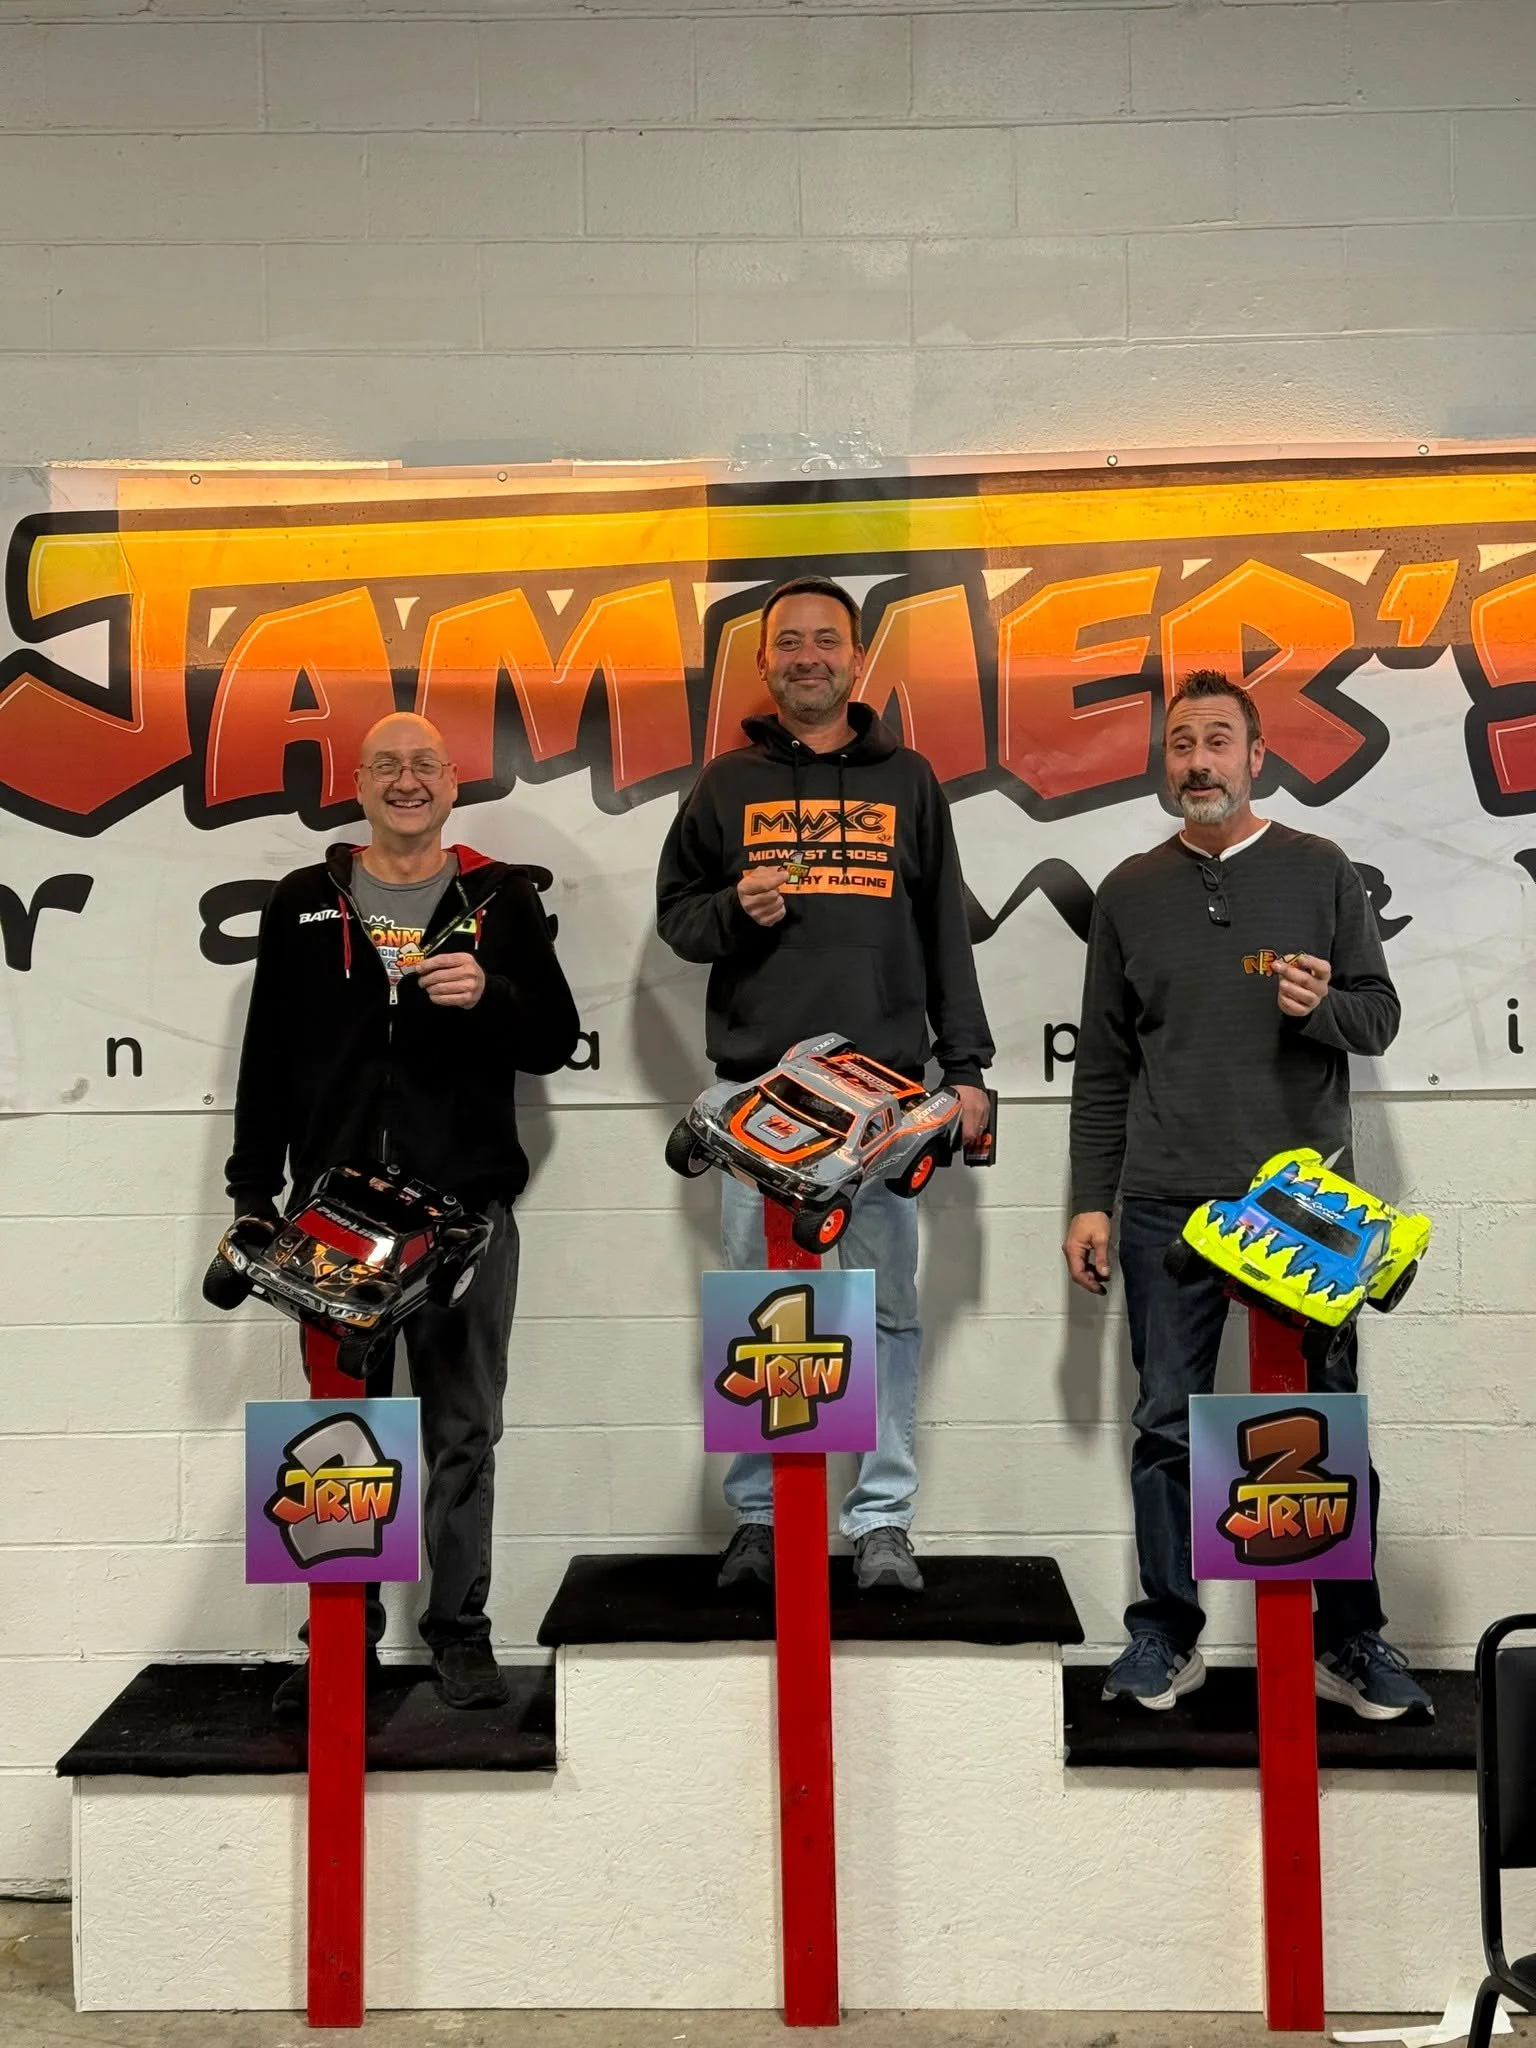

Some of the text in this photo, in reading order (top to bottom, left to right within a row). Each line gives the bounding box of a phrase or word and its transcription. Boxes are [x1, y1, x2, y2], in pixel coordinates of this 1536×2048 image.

[751, 801, 887, 841] MWXC
[748, 848, 827, 862] MIDWST
[828, 875, 887, 889] RACING
[723, 1343, 844, 1398] JRW
[272, 1467, 394, 1524] JRW
[1225, 1482, 1349, 1539] JRW
